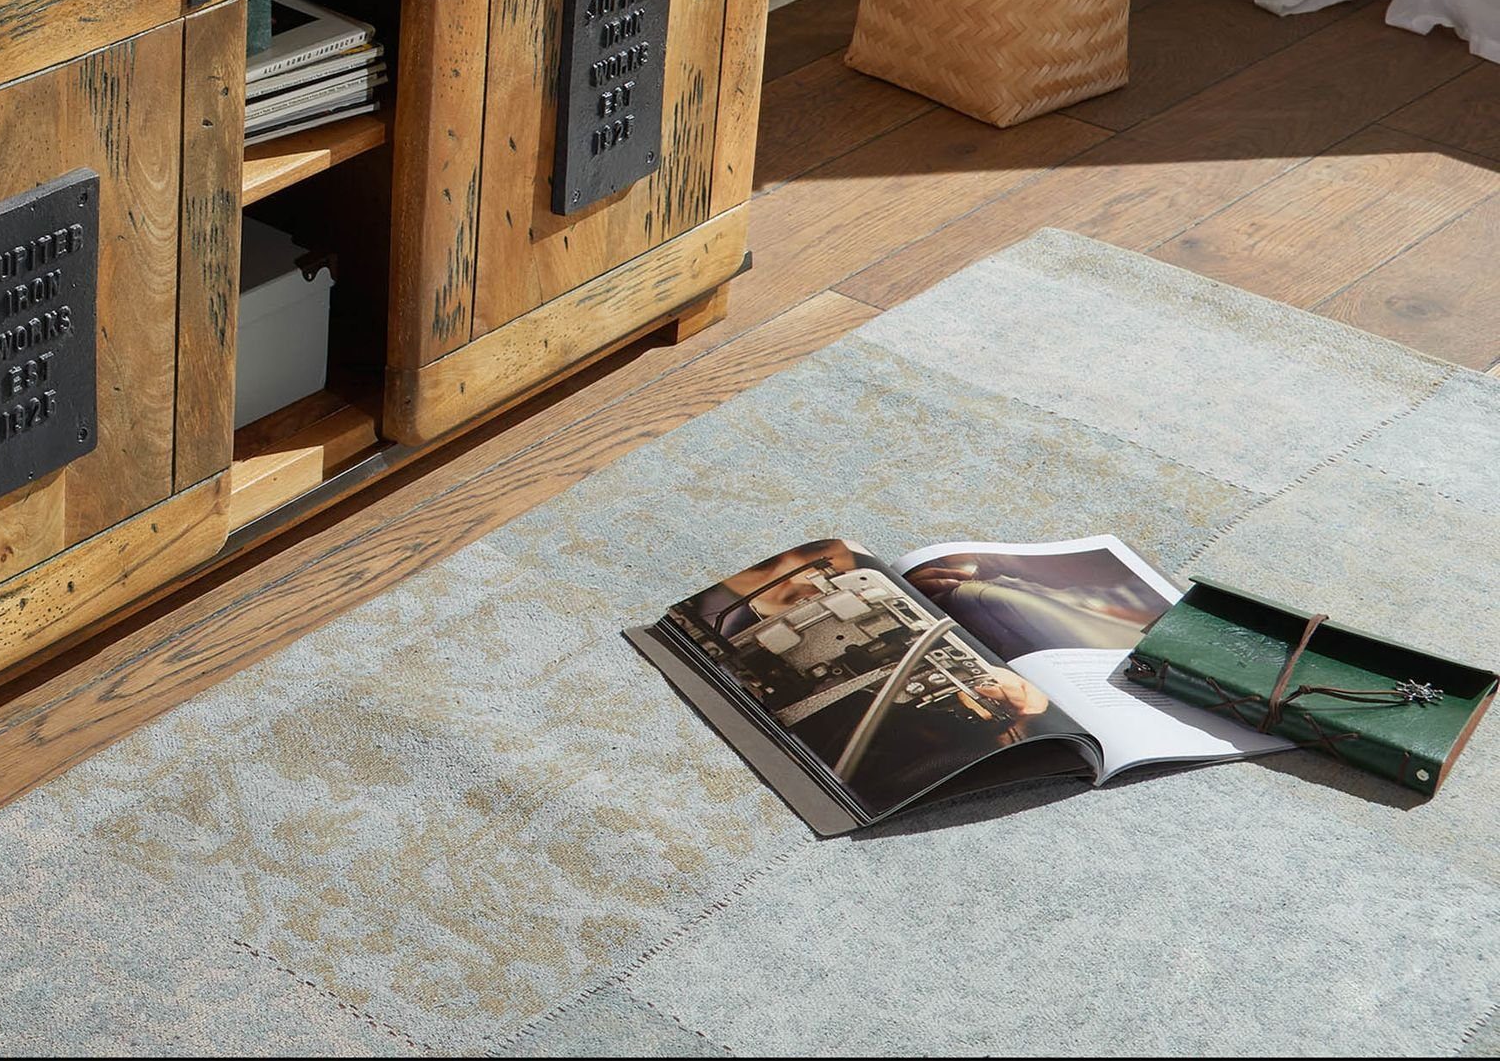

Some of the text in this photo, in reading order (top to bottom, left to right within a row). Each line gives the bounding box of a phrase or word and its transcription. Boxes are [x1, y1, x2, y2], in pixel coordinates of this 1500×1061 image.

[263, 63, 282, 75] ALFA
[286, 52, 312, 67] ROMEO
[6, 268, 62, 317] IRON
[8, 350, 55, 393] EST
[2, 389, 57, 440] 1925
